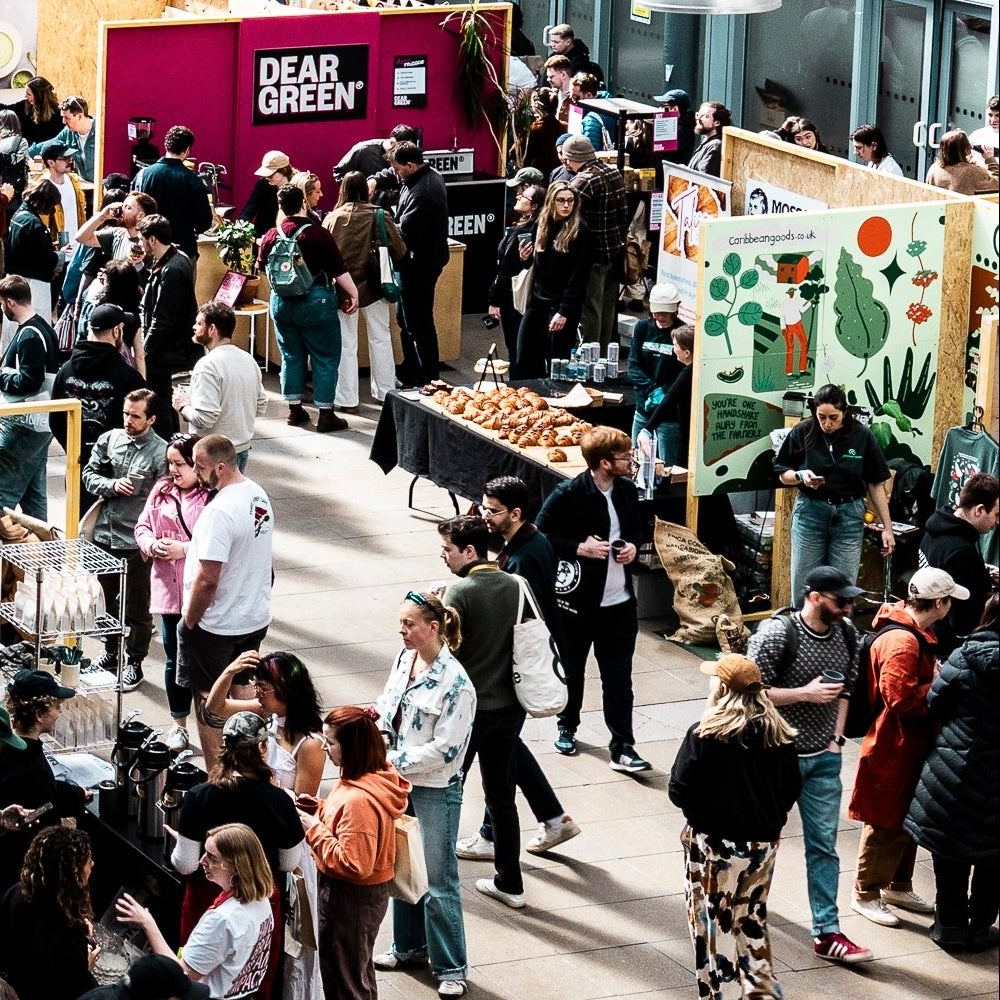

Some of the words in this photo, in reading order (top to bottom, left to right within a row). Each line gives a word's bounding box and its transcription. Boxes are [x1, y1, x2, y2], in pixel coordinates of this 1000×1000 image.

[259, 54, 340, 86] DEAR
[712, 398, 738, 410] YOU'RE
[743, 400, 757, 411] ONE
[717, 409, 760, 420] HANDSHAKE
[740, 421, 758, 430] FROM
[711, 431, 727, 441] THE
[729, 429, 762, 439] FARMERS
